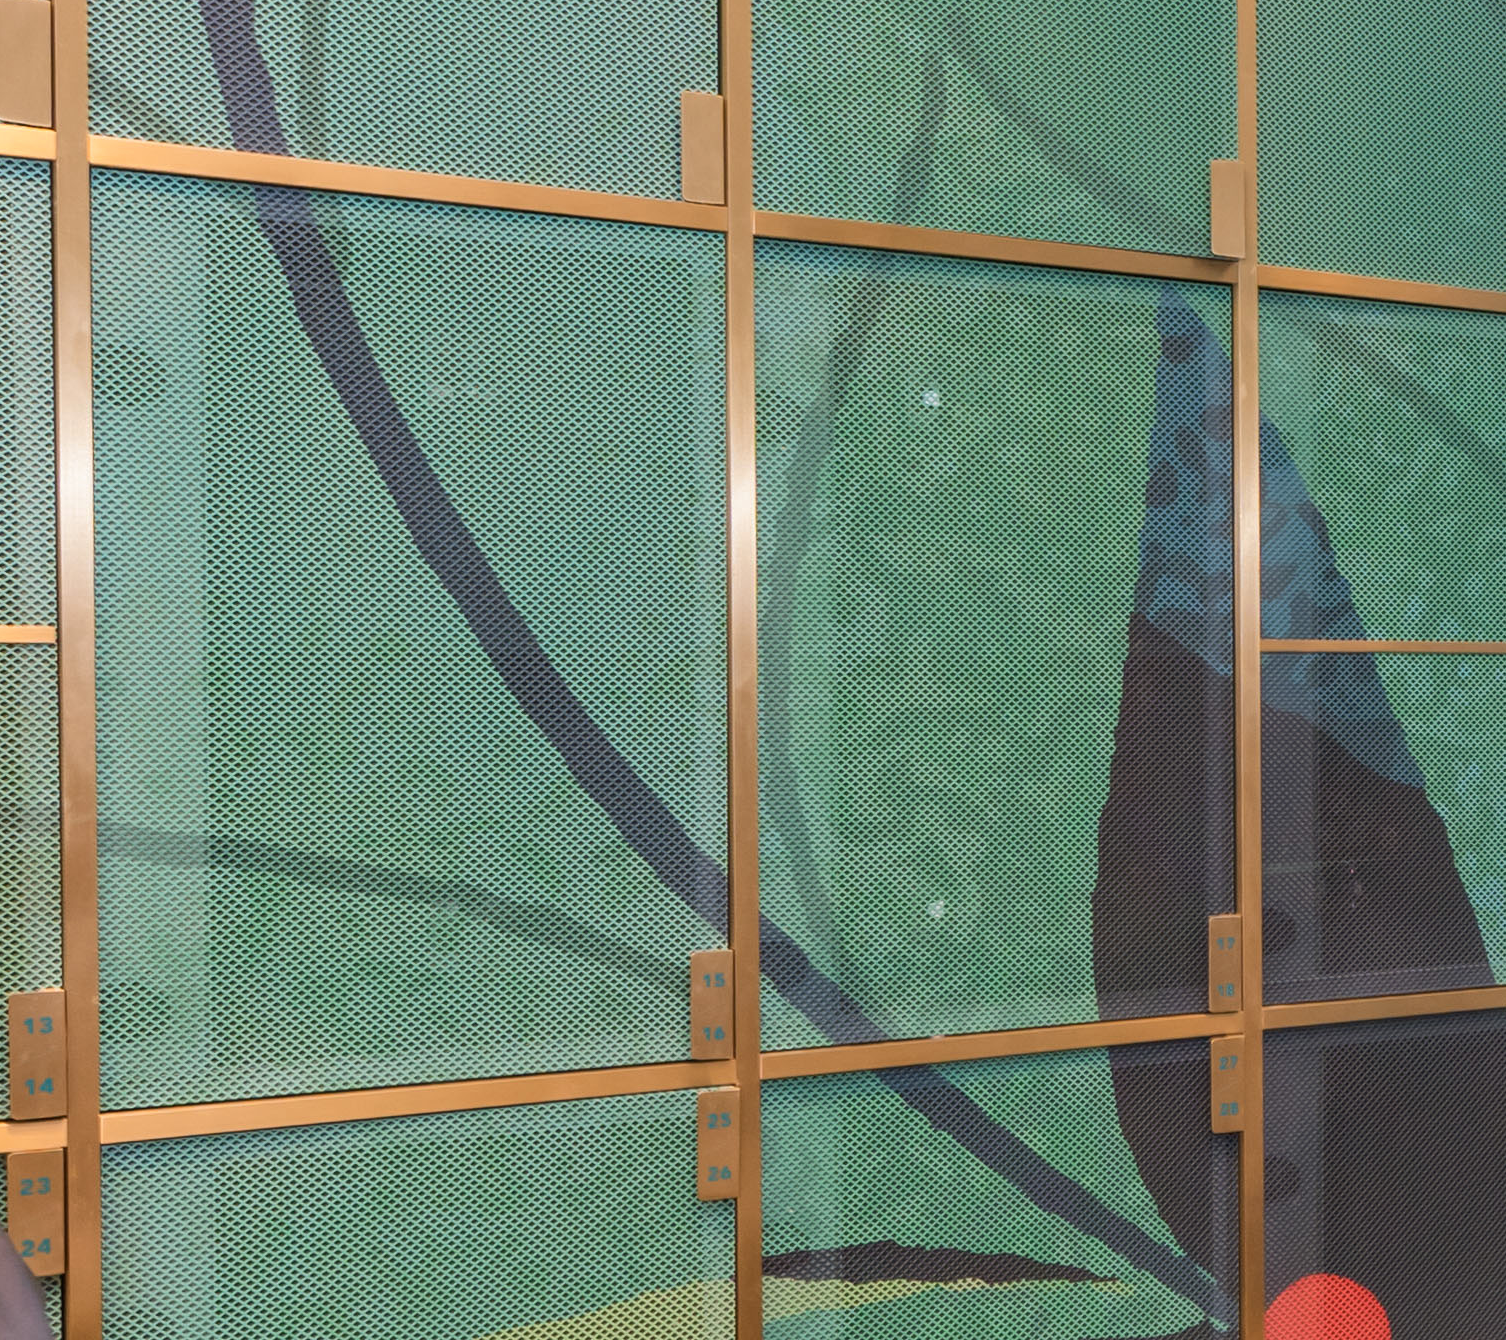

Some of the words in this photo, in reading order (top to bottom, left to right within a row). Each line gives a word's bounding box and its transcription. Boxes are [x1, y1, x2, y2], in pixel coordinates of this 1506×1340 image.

[1216, 936, 1236, 951] 17
[702, 972, 727, 988] 15
[23, 1016, 54, 1034] 13
[702, 1026, 726, 1042] 16
[1218, 1055, 1239, 1071] 27
[24, 1077, 54, 1096] 14
[706, 1112, 732, 1130] 25
[706, 1165, 732, 1182] 26
[19, 1176, 52, 1196] 23
[20, 1237, 52, 1257] 24
